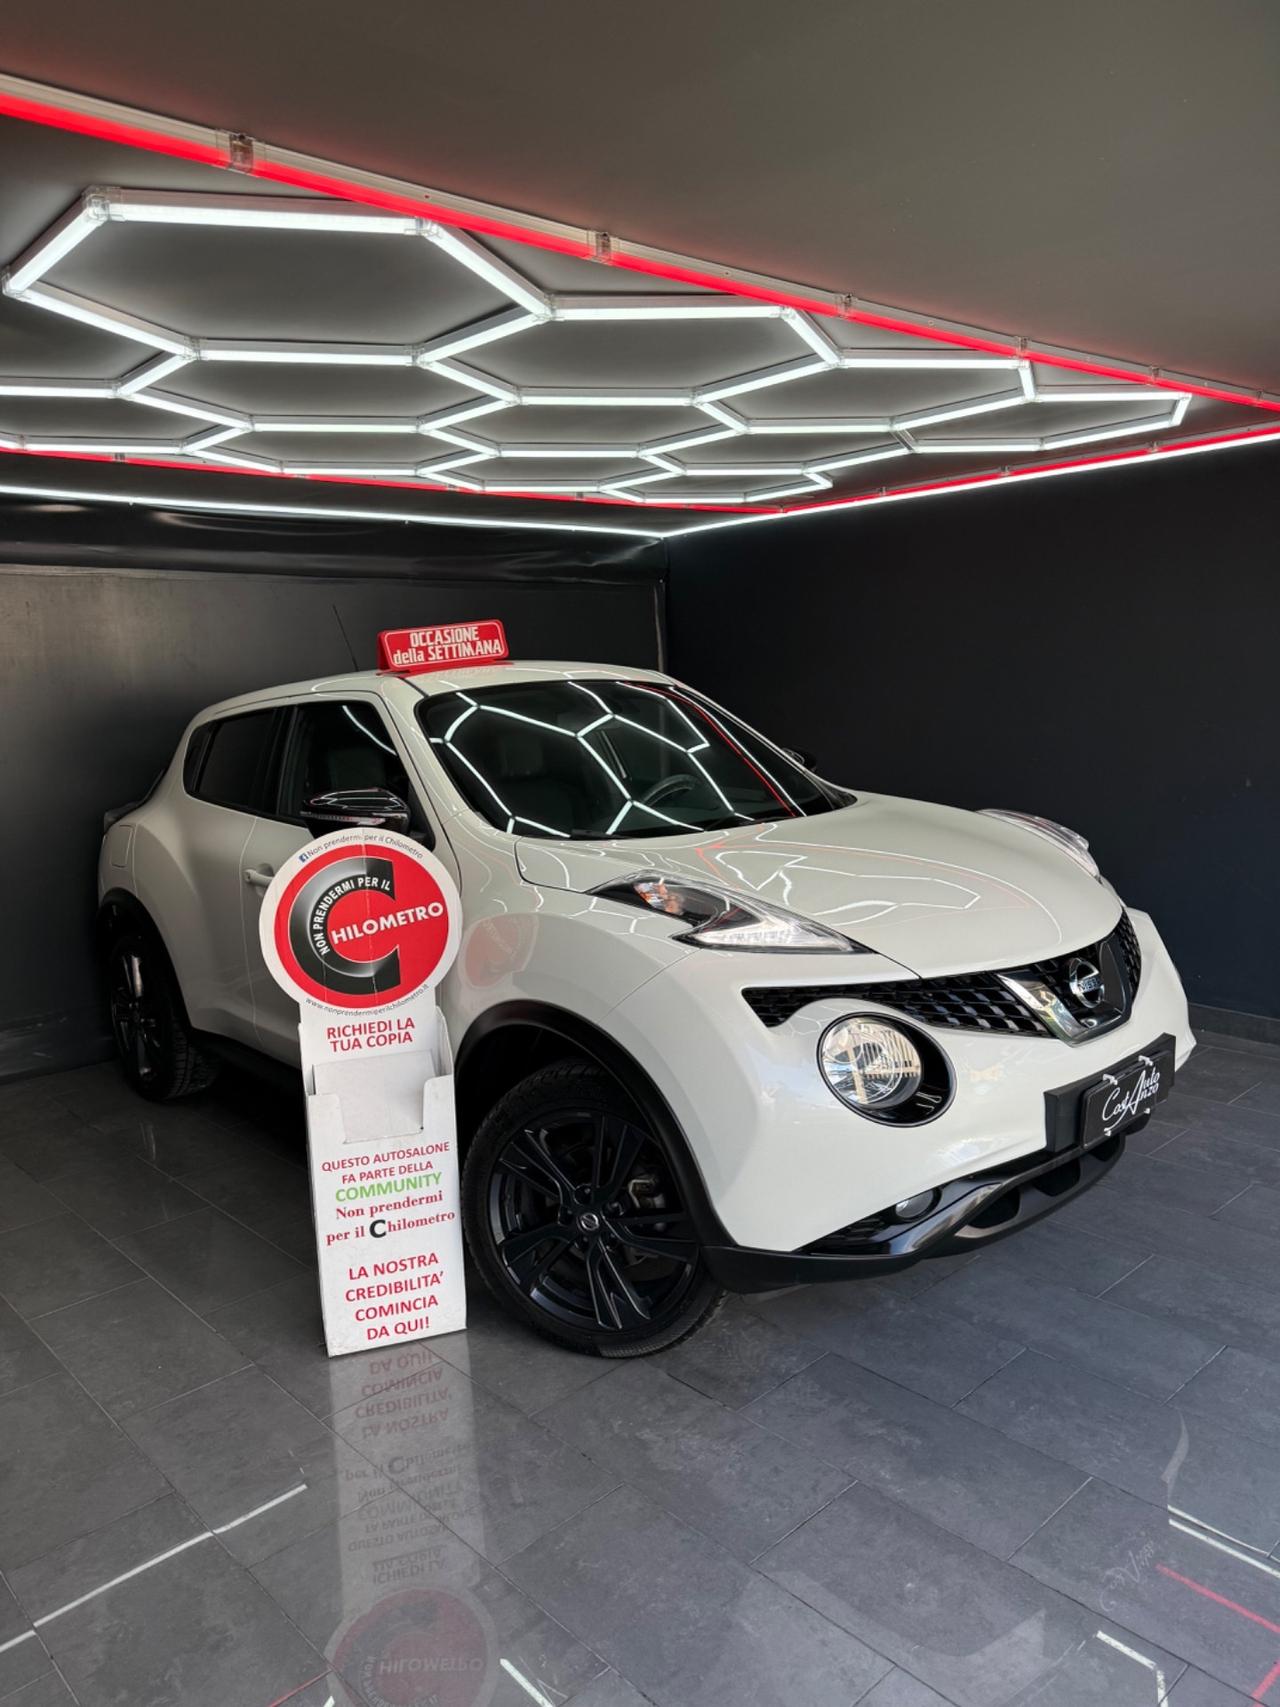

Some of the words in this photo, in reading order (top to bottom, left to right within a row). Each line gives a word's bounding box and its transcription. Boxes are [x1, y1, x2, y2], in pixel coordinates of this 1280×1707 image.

[411, 627, 480, 647] OCCASIONE
[393, 648, 425, 665] della
[427, 639, 503, 661] SETTIMANA
[308, 845, 324, 857] Non
[364, 833, 378, 844] per
[385, 836, 423, 859] Chilometro
[357, 876, 379, 888] PER
[380, 878, 391, 891] IL
[313, 878, 355, 931] PRENDERMI
[313, 931, 331, 956] NON
[326, 1018, 393, 1040] RICHIEDI
[396, 1016, 416, 1031] LA
[330, 1037, 363, 1053] TUA
[366, 1031, 413, 1048] COPIA
[321, 1154, 371, 1173] QUESTO
[372, 1141, 451, 1165] AUTOSALONE
[341, 1172, 357, 1185] FA
[359, 1167, 395, 1182] PARTE
[398, 1160, 434, 1177] DELLA
[335, 1172, 442, 1202] COMMUNITY
[336, 1205, 365, 1220] Non
[369, 1190, 444, 1218] prendermi
[326, 1227, 351, 1246] per
[354, 1223, 366, 1239] il
[369, 1210, 456, 1239] Chilometro
[348, 1266, 369, 1281] LA
[373, 1252, 439, 1277] NOSTRA
[345, 1270, 445, 1303] CREDIBILITA'
[355, 1294, 439, 1323] COMINCIA
[366, 1326, 390, 1341] DA
[394, 1316, 430, 1337] QUI!
